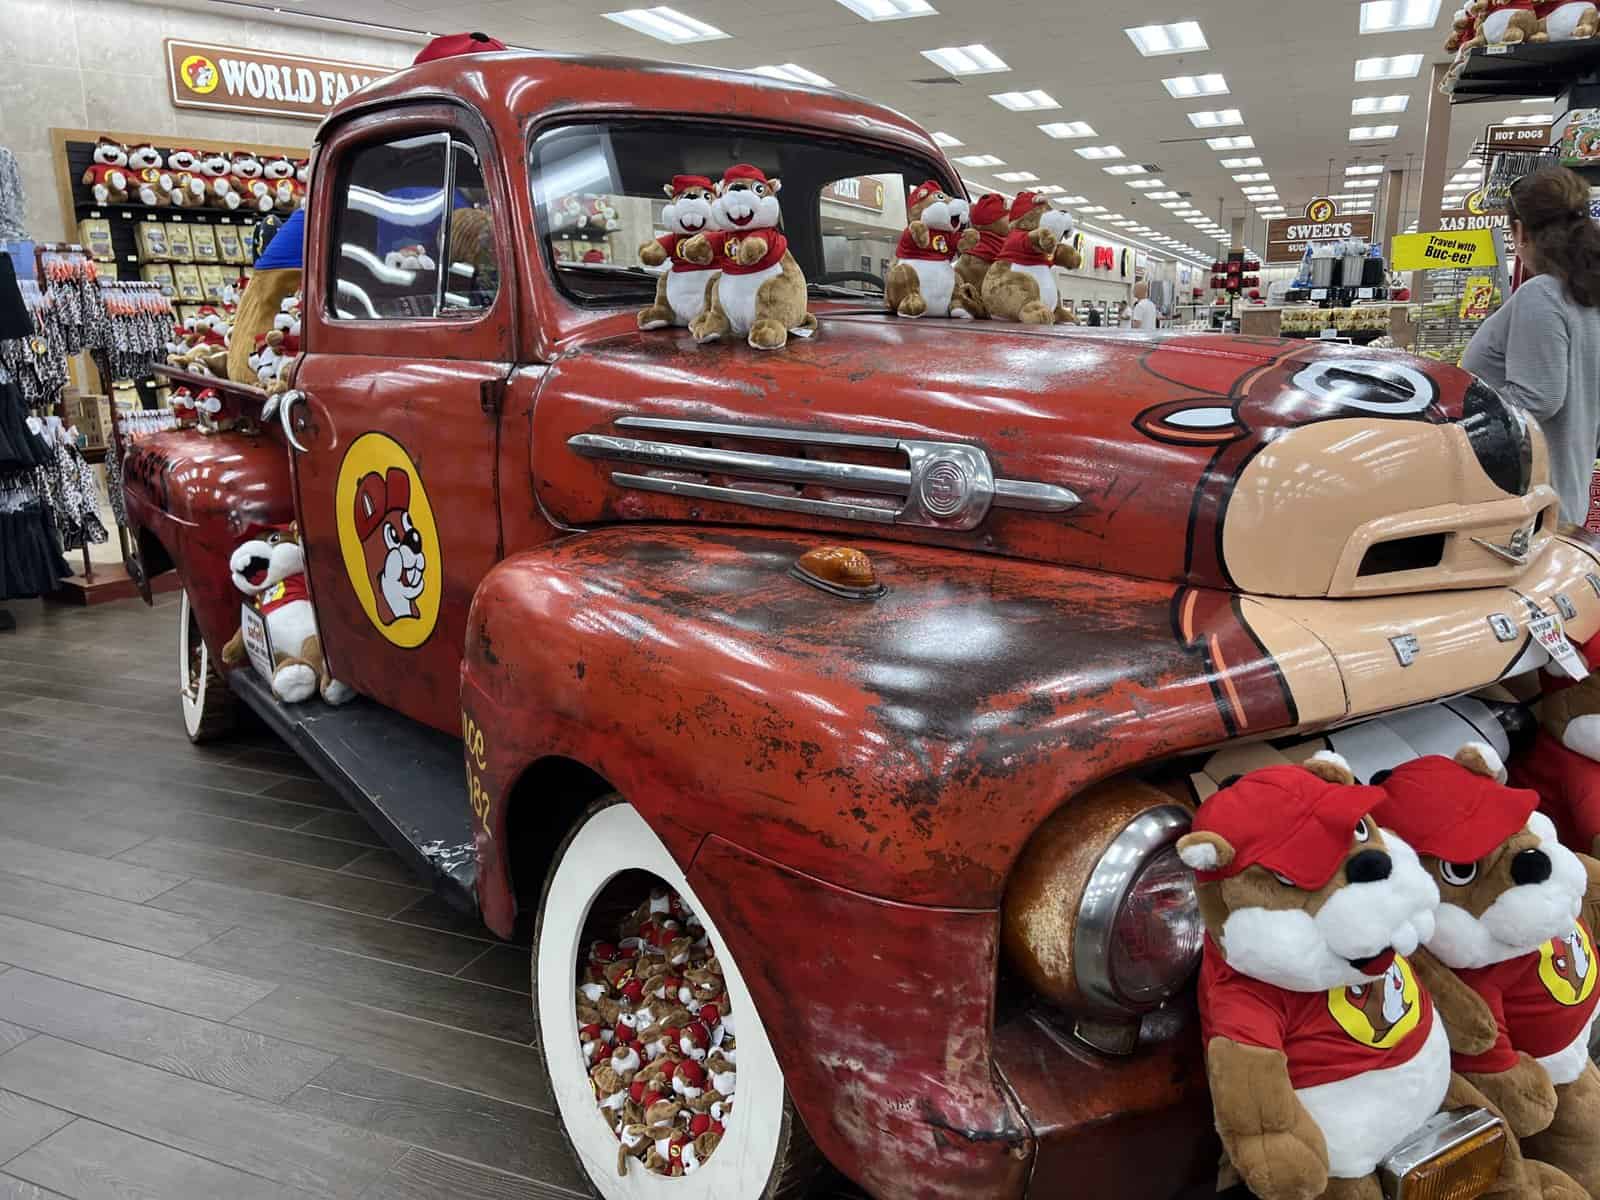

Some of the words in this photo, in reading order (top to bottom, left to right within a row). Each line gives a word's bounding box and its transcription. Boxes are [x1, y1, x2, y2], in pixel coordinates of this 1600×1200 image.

[218, 58, 317, 104] WORLD
[1495, 131, 1516, 141] HOT
[1517, 130, 1544, 140] DOGS
[1287, 222, 1353, 240] SWEETS
[1288, 243, 1307, 252] SUG
[1430, 236, 1457, 249] Travel
[1457, 241, 1477, 252] with
[1425, 245, 1473, 264] Buc-ee!
